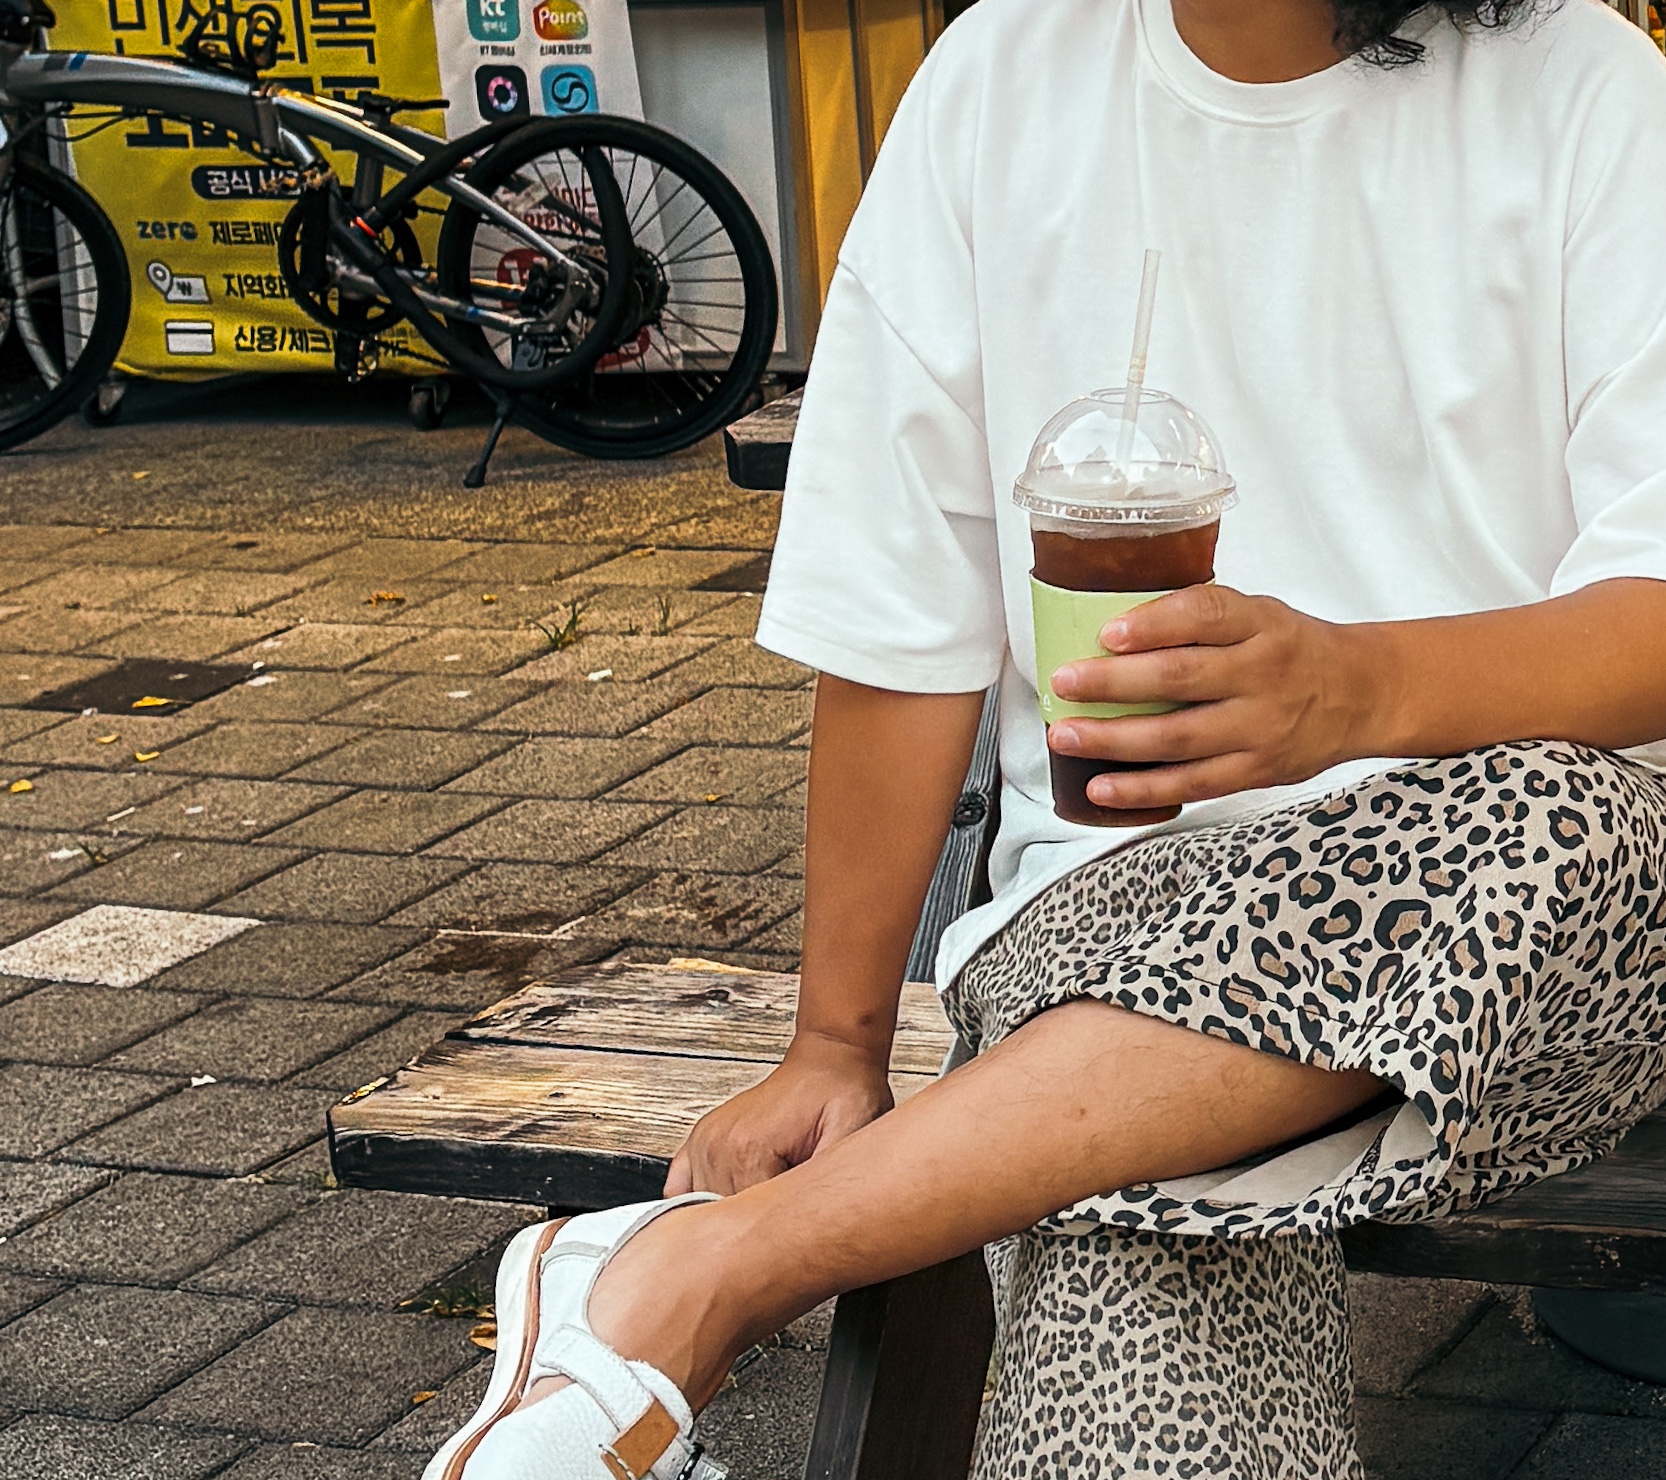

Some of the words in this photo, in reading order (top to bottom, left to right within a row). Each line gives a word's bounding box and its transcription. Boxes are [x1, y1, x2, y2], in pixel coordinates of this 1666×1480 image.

[207, 170, 253, 196] 공식
[137, 221, 198, 240] zero
[209, 221, 282, 245] 제로페
[223, 274, 290, 299] 지역화
[234, 326, 333, 354] 신용/체크
